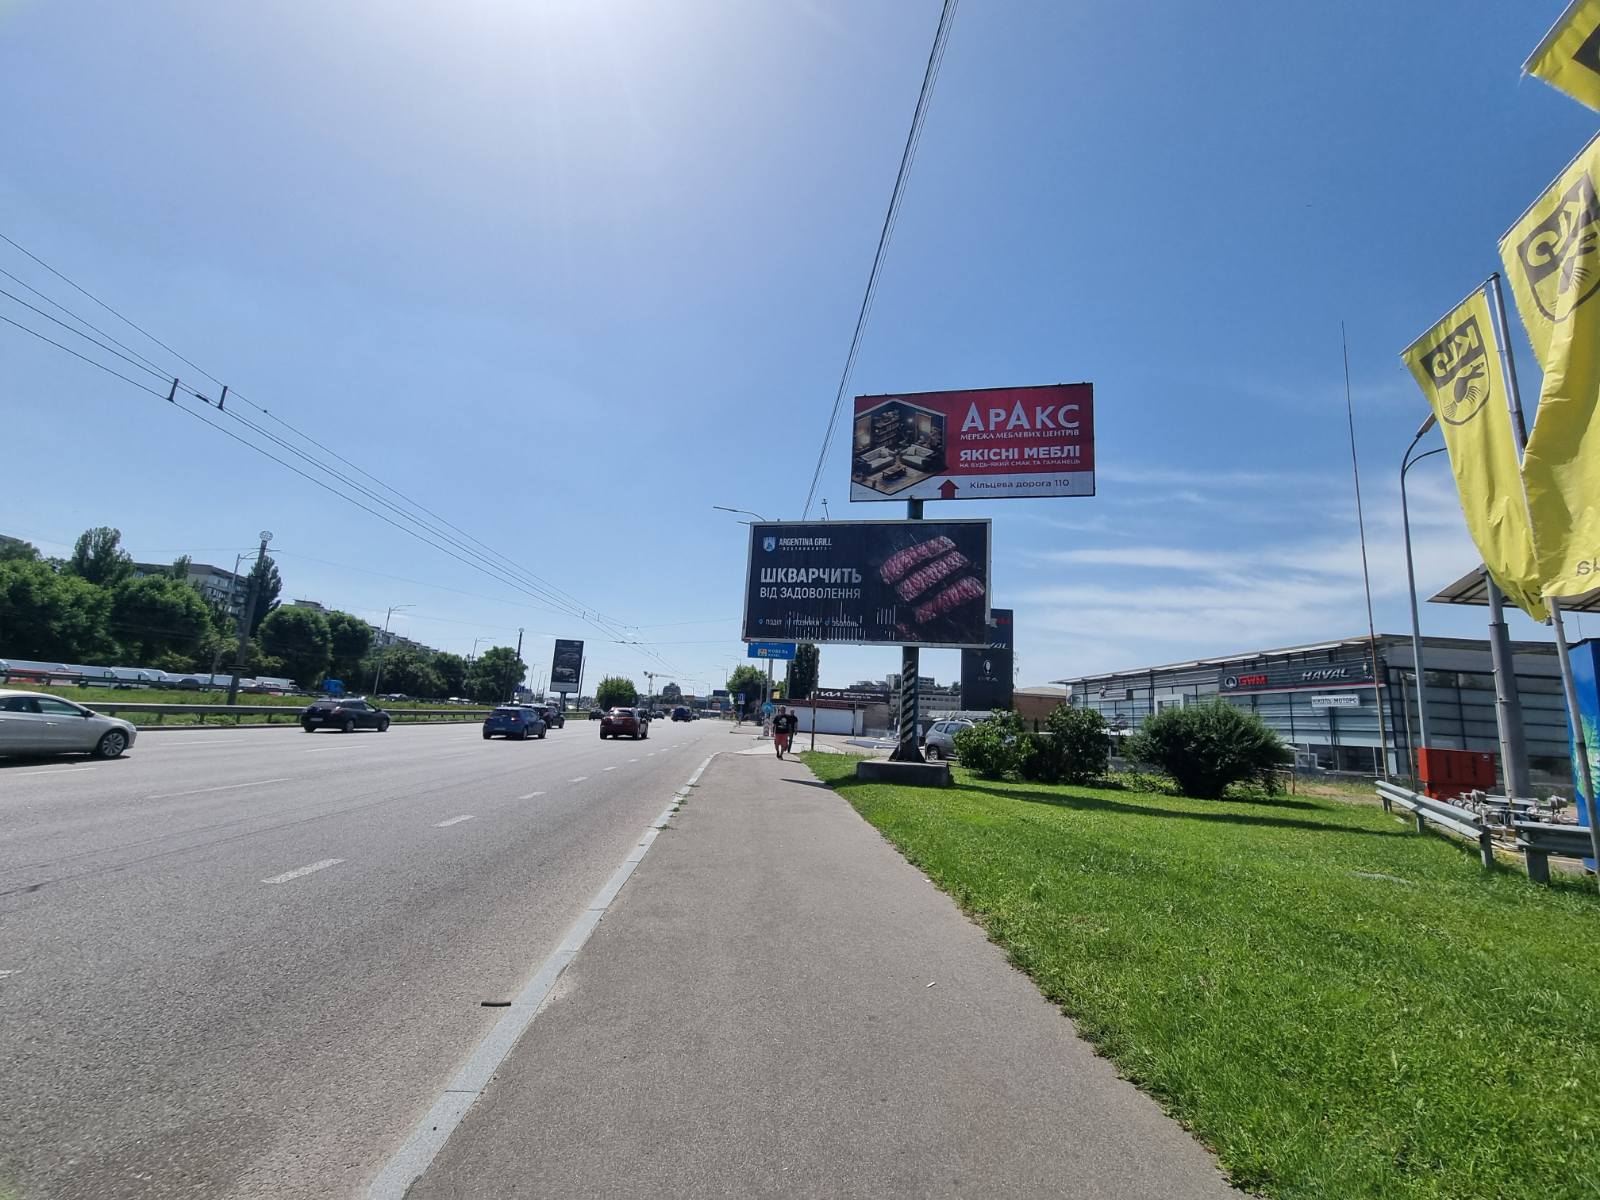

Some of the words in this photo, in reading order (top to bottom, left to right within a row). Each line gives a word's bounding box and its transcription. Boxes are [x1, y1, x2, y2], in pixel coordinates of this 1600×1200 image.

[960, 433, 994, 441] МЕРЕЖА
[995, 431, 1041, 440] МЕБЛЕВИХ
[1042, 430, 1080, 438] ЦЕНТРІВ
[960, 447, 1019, 461] ЯКІСНІ
[1024, 445, 1080, 459] МЕБЛІ
[969, 480, 1014, 489] Кільцева
[1015, 479, 1052, 489] дорога
[1054, 479, 1070, 488] 110
[778, 537, 814, 546] ARGENTINA
[814, 537, 833, 546] GRILL
[760, 567, 862, 584] ШКВАРЧИТЬ
[760, 587, 778, 600] ВІД
[780, 586, 861, 599] ЗАДОВОЛЕННЯ
[1301, 668, 1350, 681] HAVAL
[1238, 675, 1268, 687] GWM
